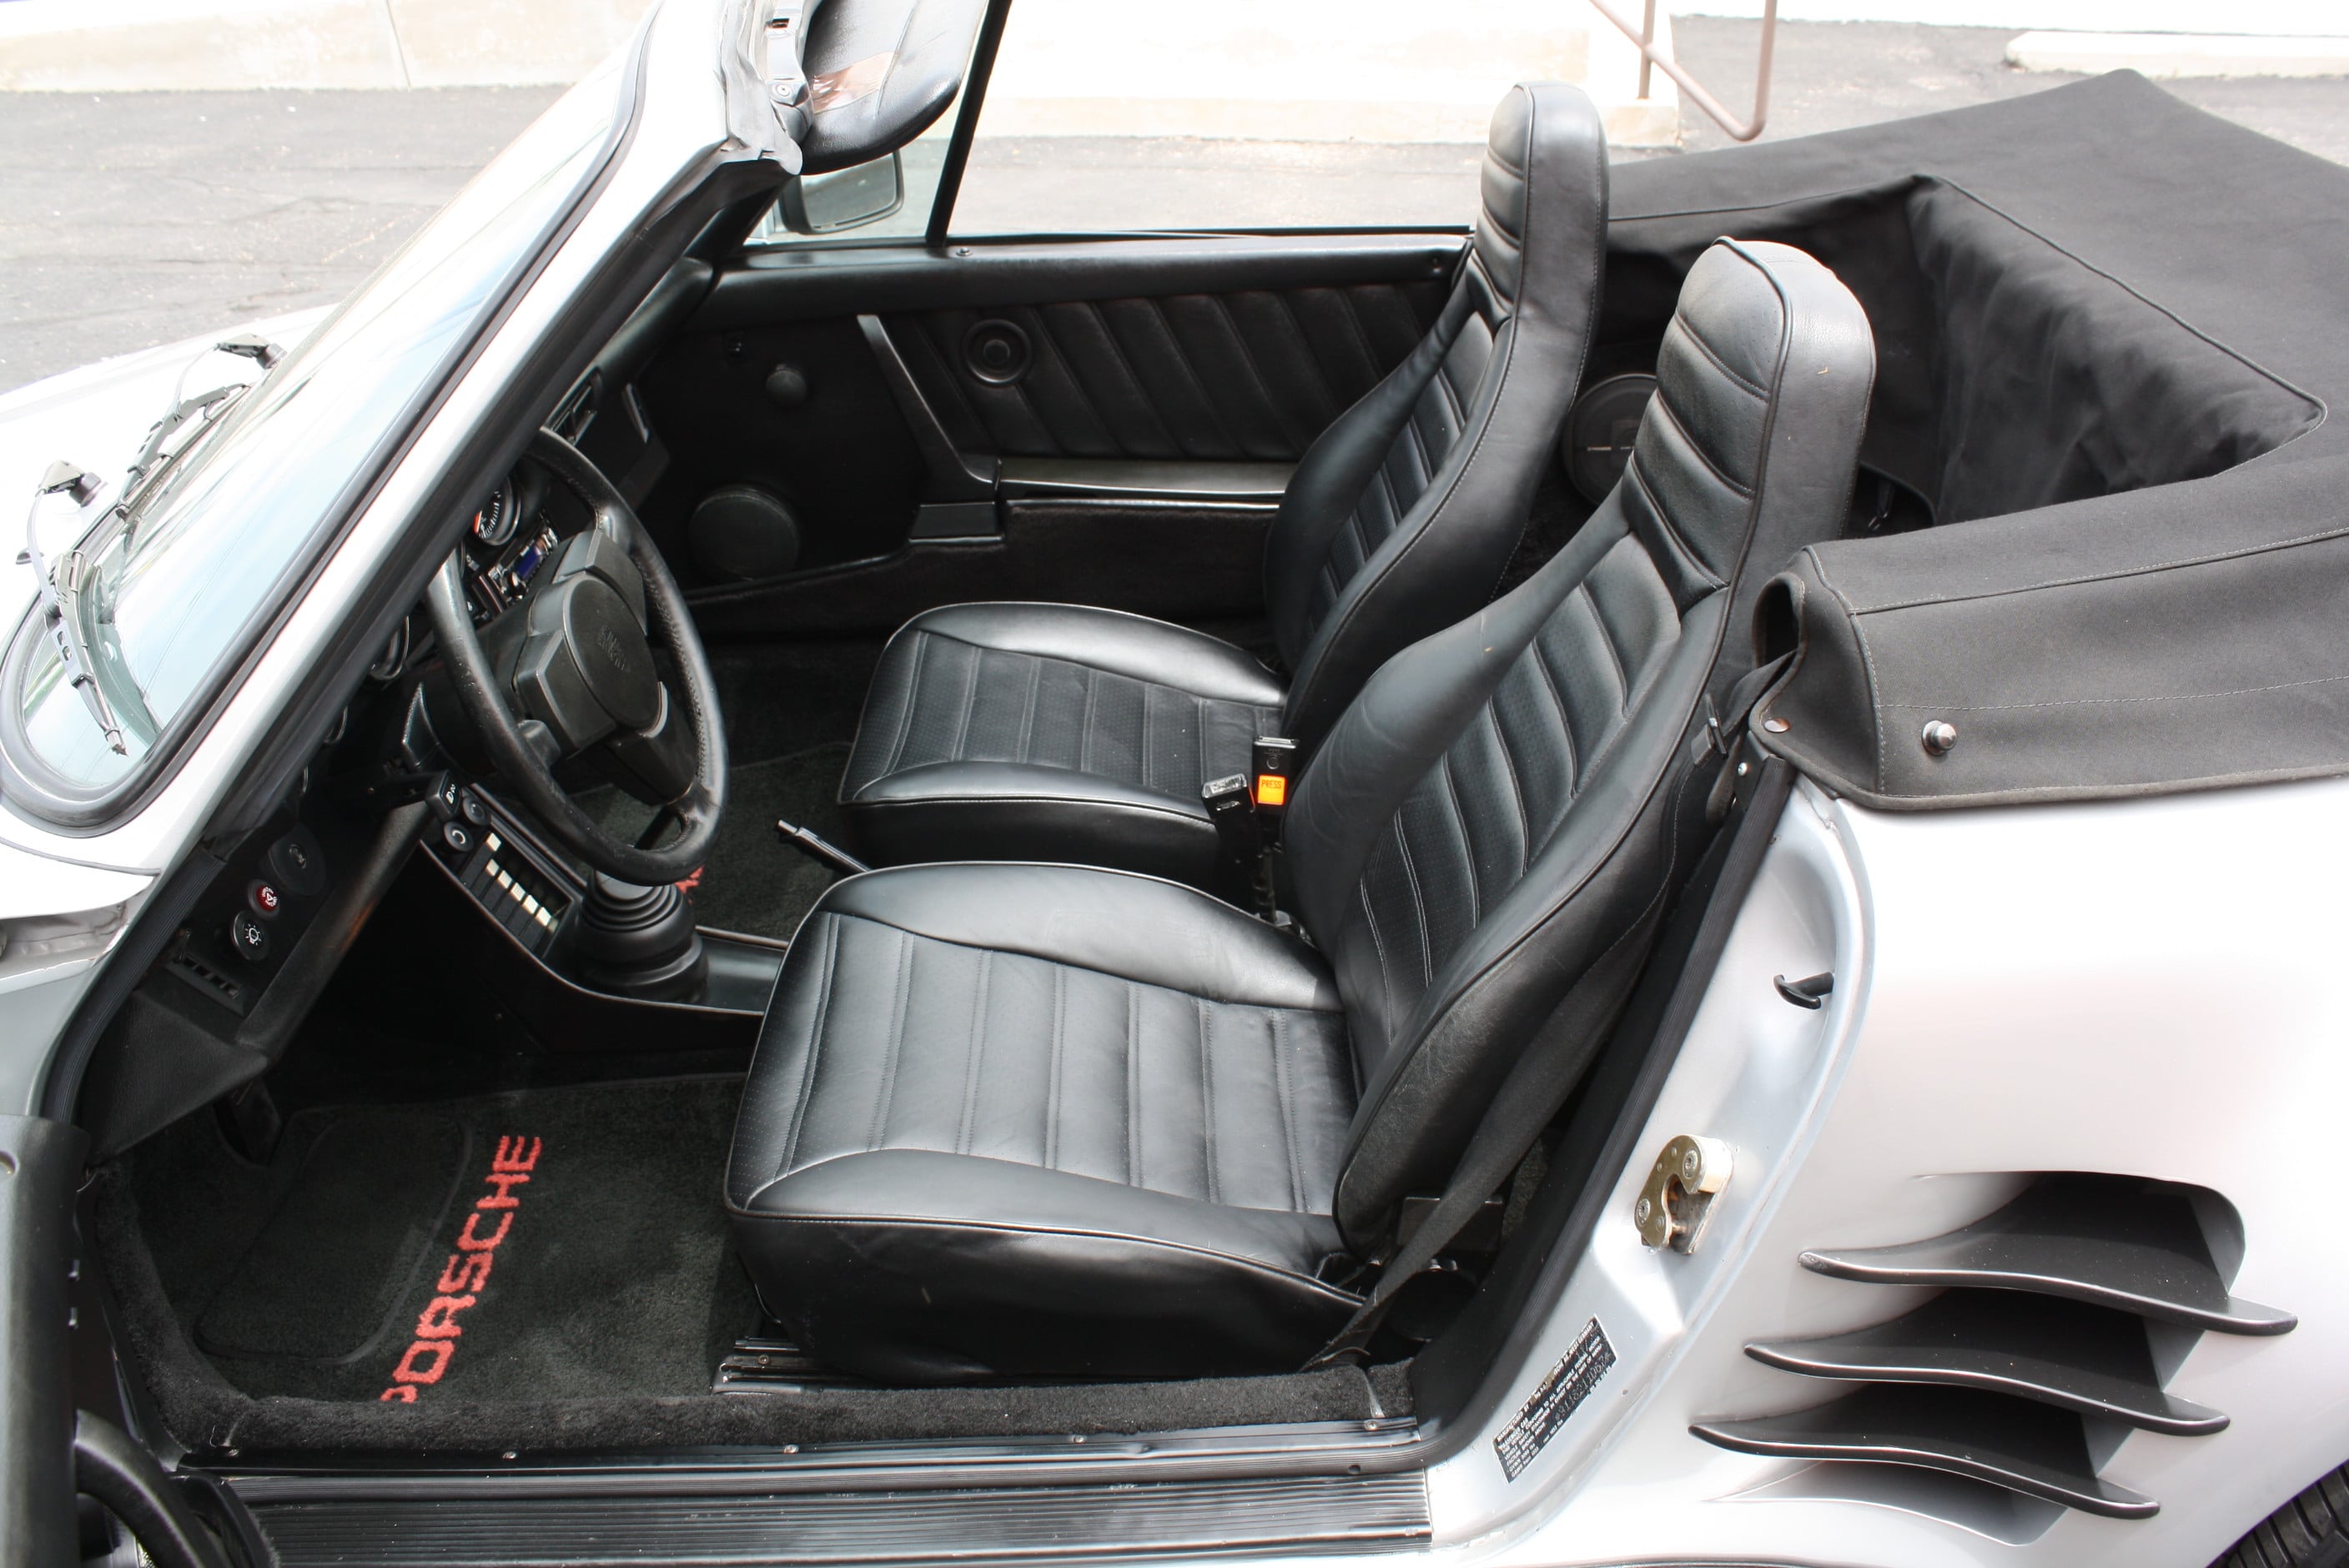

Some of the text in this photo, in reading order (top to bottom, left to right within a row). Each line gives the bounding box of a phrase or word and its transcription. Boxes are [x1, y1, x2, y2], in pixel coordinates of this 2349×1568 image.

[1261, 780, 1282, 789] PRESS
[1565, 1379, 1572, 1390] ON
[1586, 1354, 1592, 1364] OF
[1543, 1399, 1549, 1409] TO
[1519, 1415, 1528, 1429] CAR
